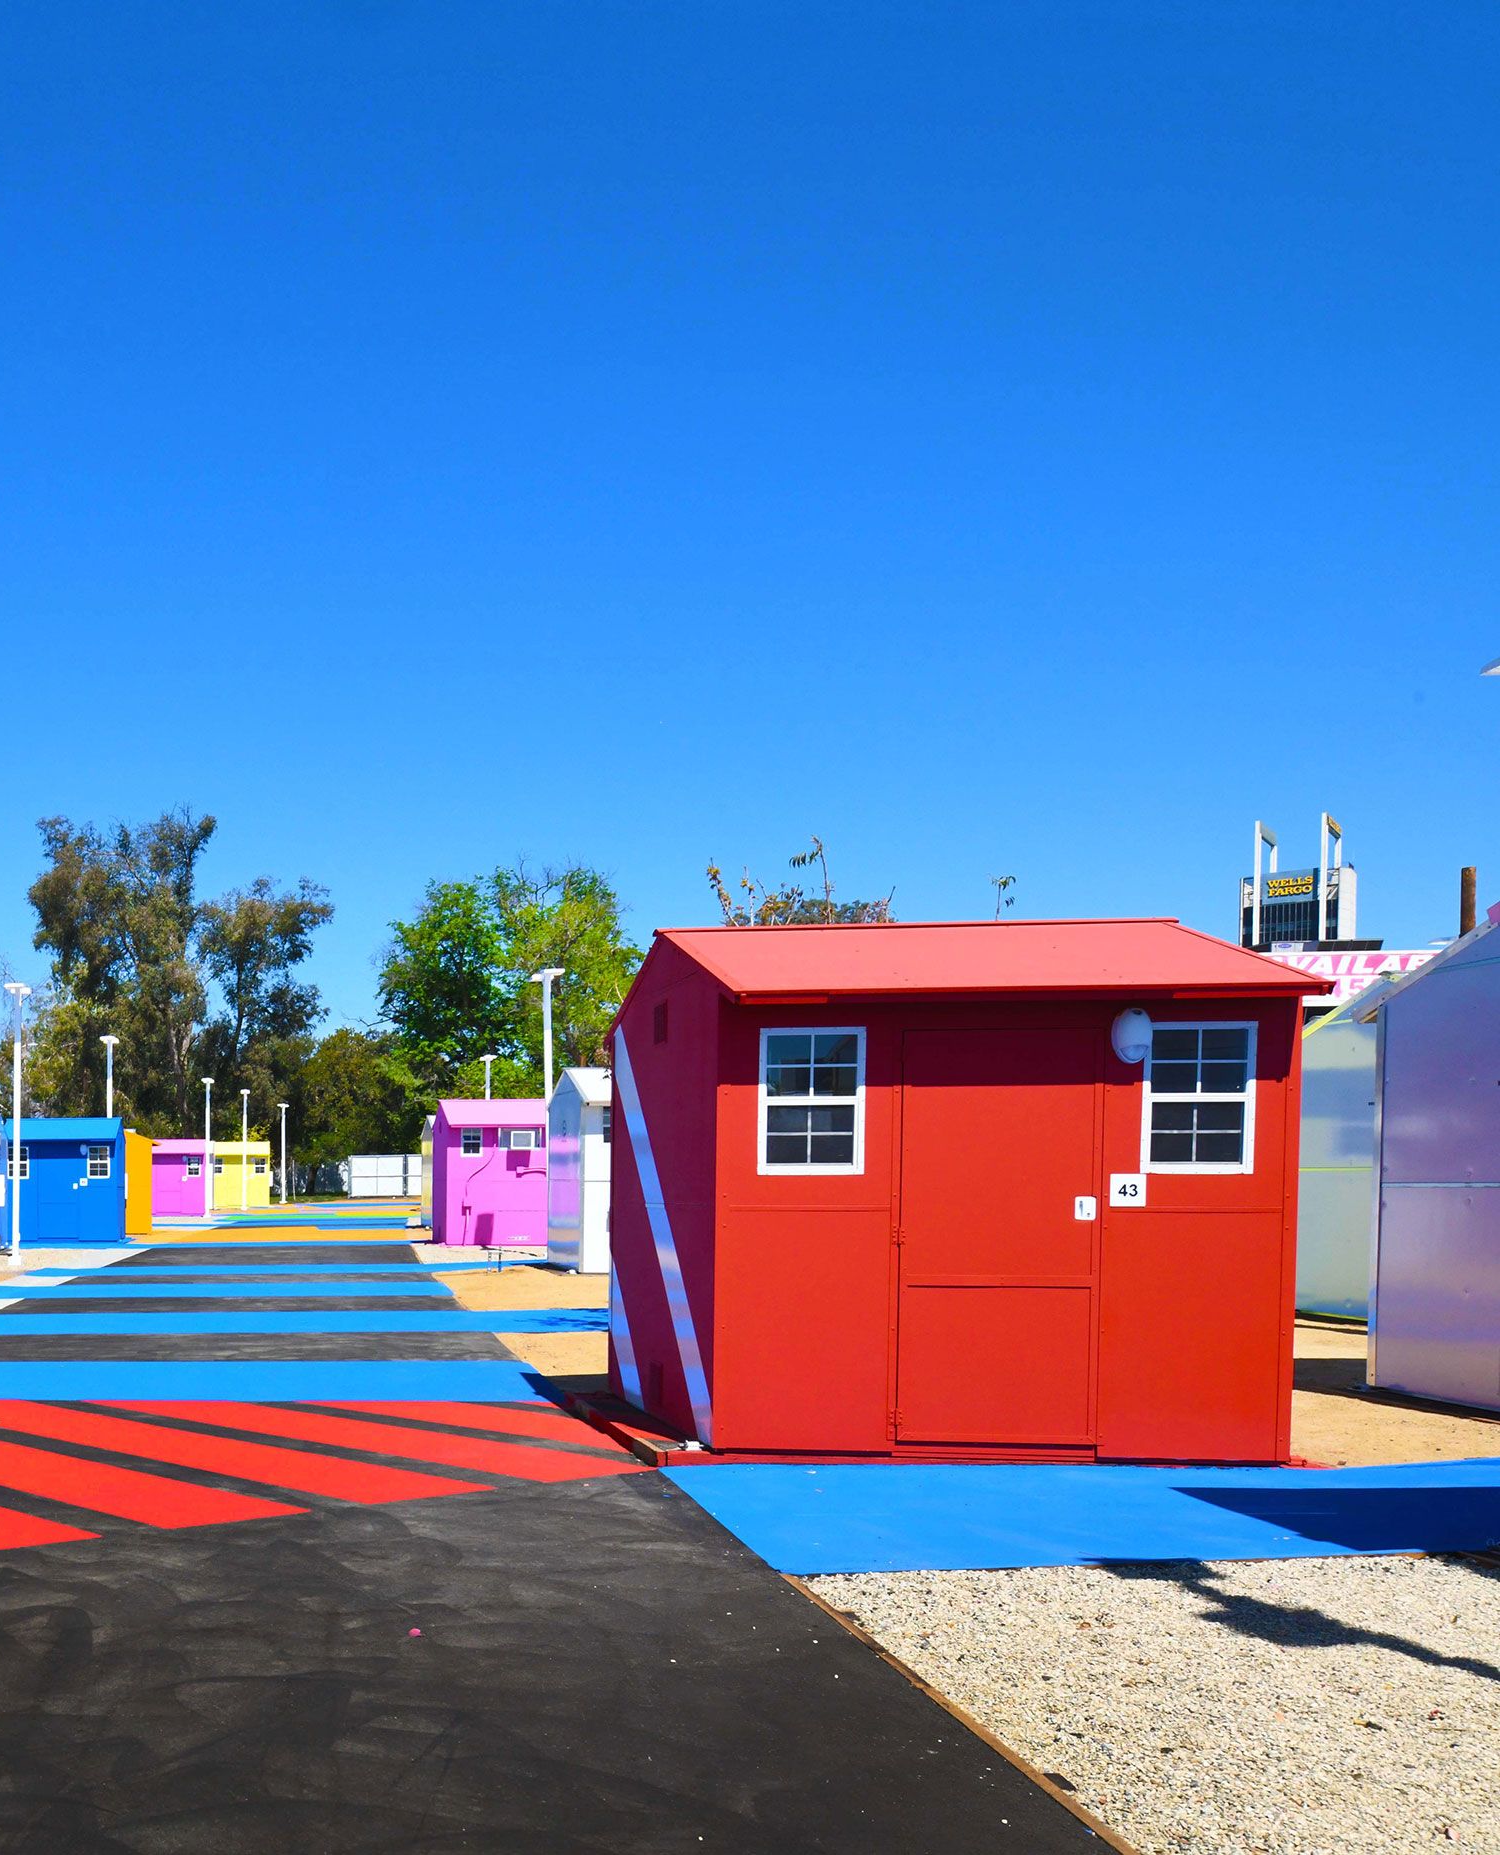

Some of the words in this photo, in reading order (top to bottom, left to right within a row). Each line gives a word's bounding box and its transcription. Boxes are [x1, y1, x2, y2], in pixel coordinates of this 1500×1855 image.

[1267, 876, 1313, 888] WELLS
[1268, 885, 1312, 897] FARGO
[1271, 954, 1437, 974] VAILA
[1118, 1184, 1138, 1197] 43
